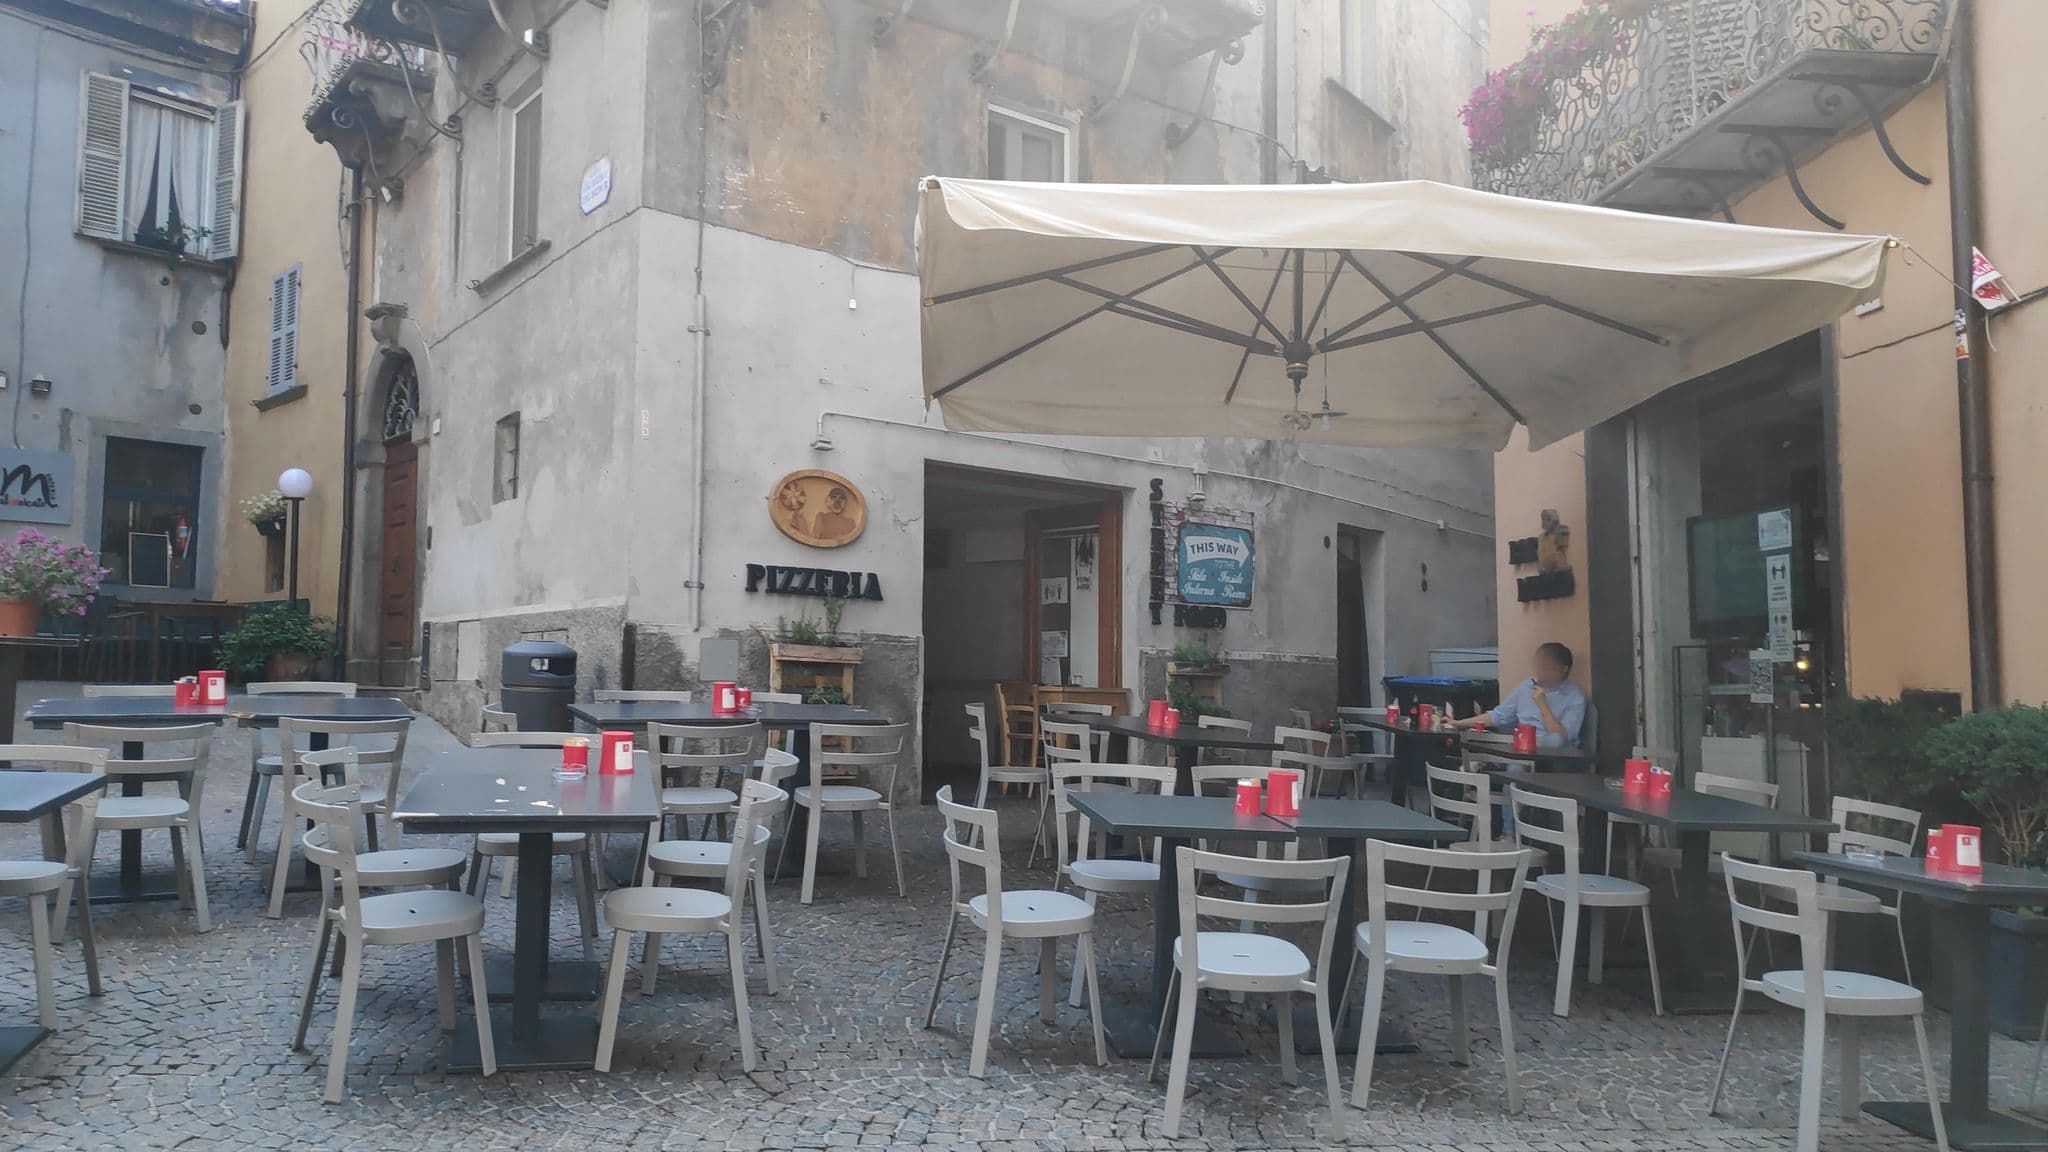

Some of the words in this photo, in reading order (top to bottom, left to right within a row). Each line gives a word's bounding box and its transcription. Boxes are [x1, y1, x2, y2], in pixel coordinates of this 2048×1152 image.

[1190, 542, 1214, 555] THIS
[1216, 542, 1239, 555] WAY
[745, 563, 884, 601] PIZZERIA
